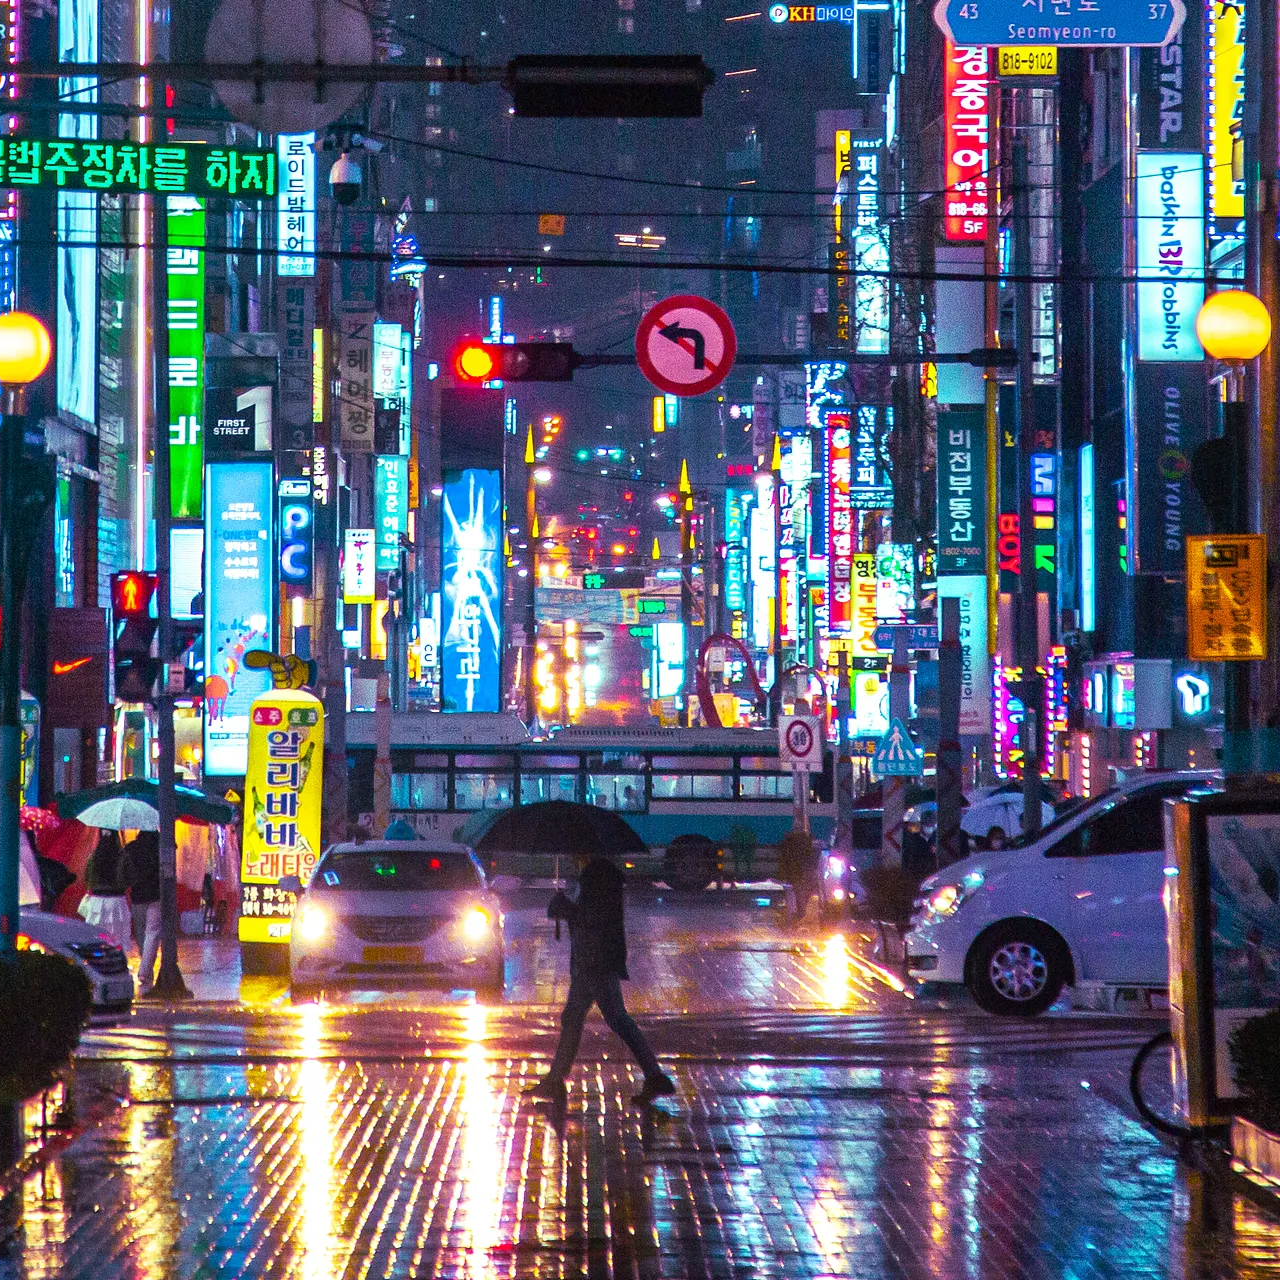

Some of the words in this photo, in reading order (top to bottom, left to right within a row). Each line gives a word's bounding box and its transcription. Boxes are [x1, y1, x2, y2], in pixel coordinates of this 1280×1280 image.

[959, 5, 979, 20] 43
[1148, 4, 1168, 19] 37
[1008, 23, 1116, 40] Seomyeon-ro
[1003, 51, 1053, 74] 818-9102
[206, 149, 275, 195] 하지
[963, 221, 984, 233] 5F
[949, 430, 974, 541] 비전부동산
[283, 504, 311, 578] PC
[265, 729, 301, 848] 알리바바
